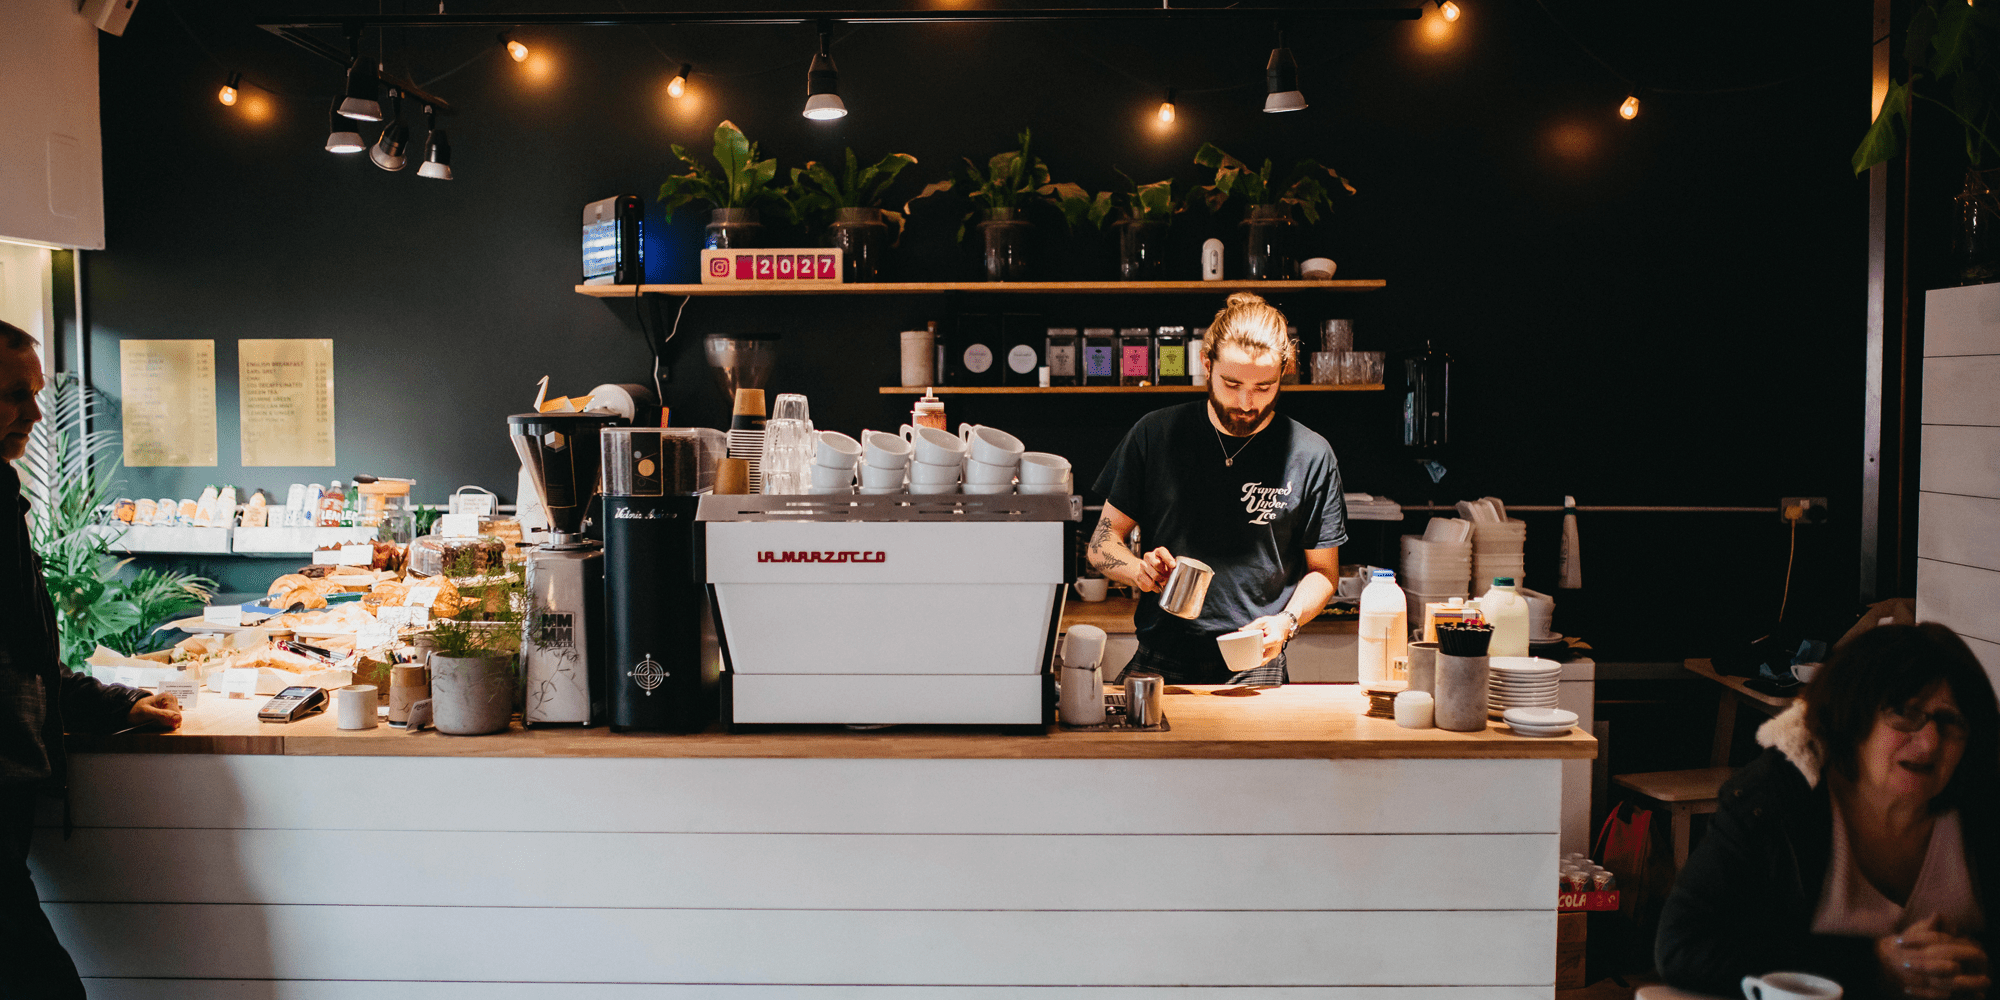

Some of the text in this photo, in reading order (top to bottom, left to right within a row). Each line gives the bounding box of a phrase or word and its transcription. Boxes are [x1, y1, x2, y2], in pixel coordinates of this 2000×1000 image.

[760, 258, 832, 275] 2027
[1241, 481, 1292, 502] Trapped
[1246, 495, 1288, 514] Under
[1248, 508, 1277, 526] Ice
[758, 551, 885, 563] LA MARZOCCO
[1558, 894, 1587, 908] COLA
